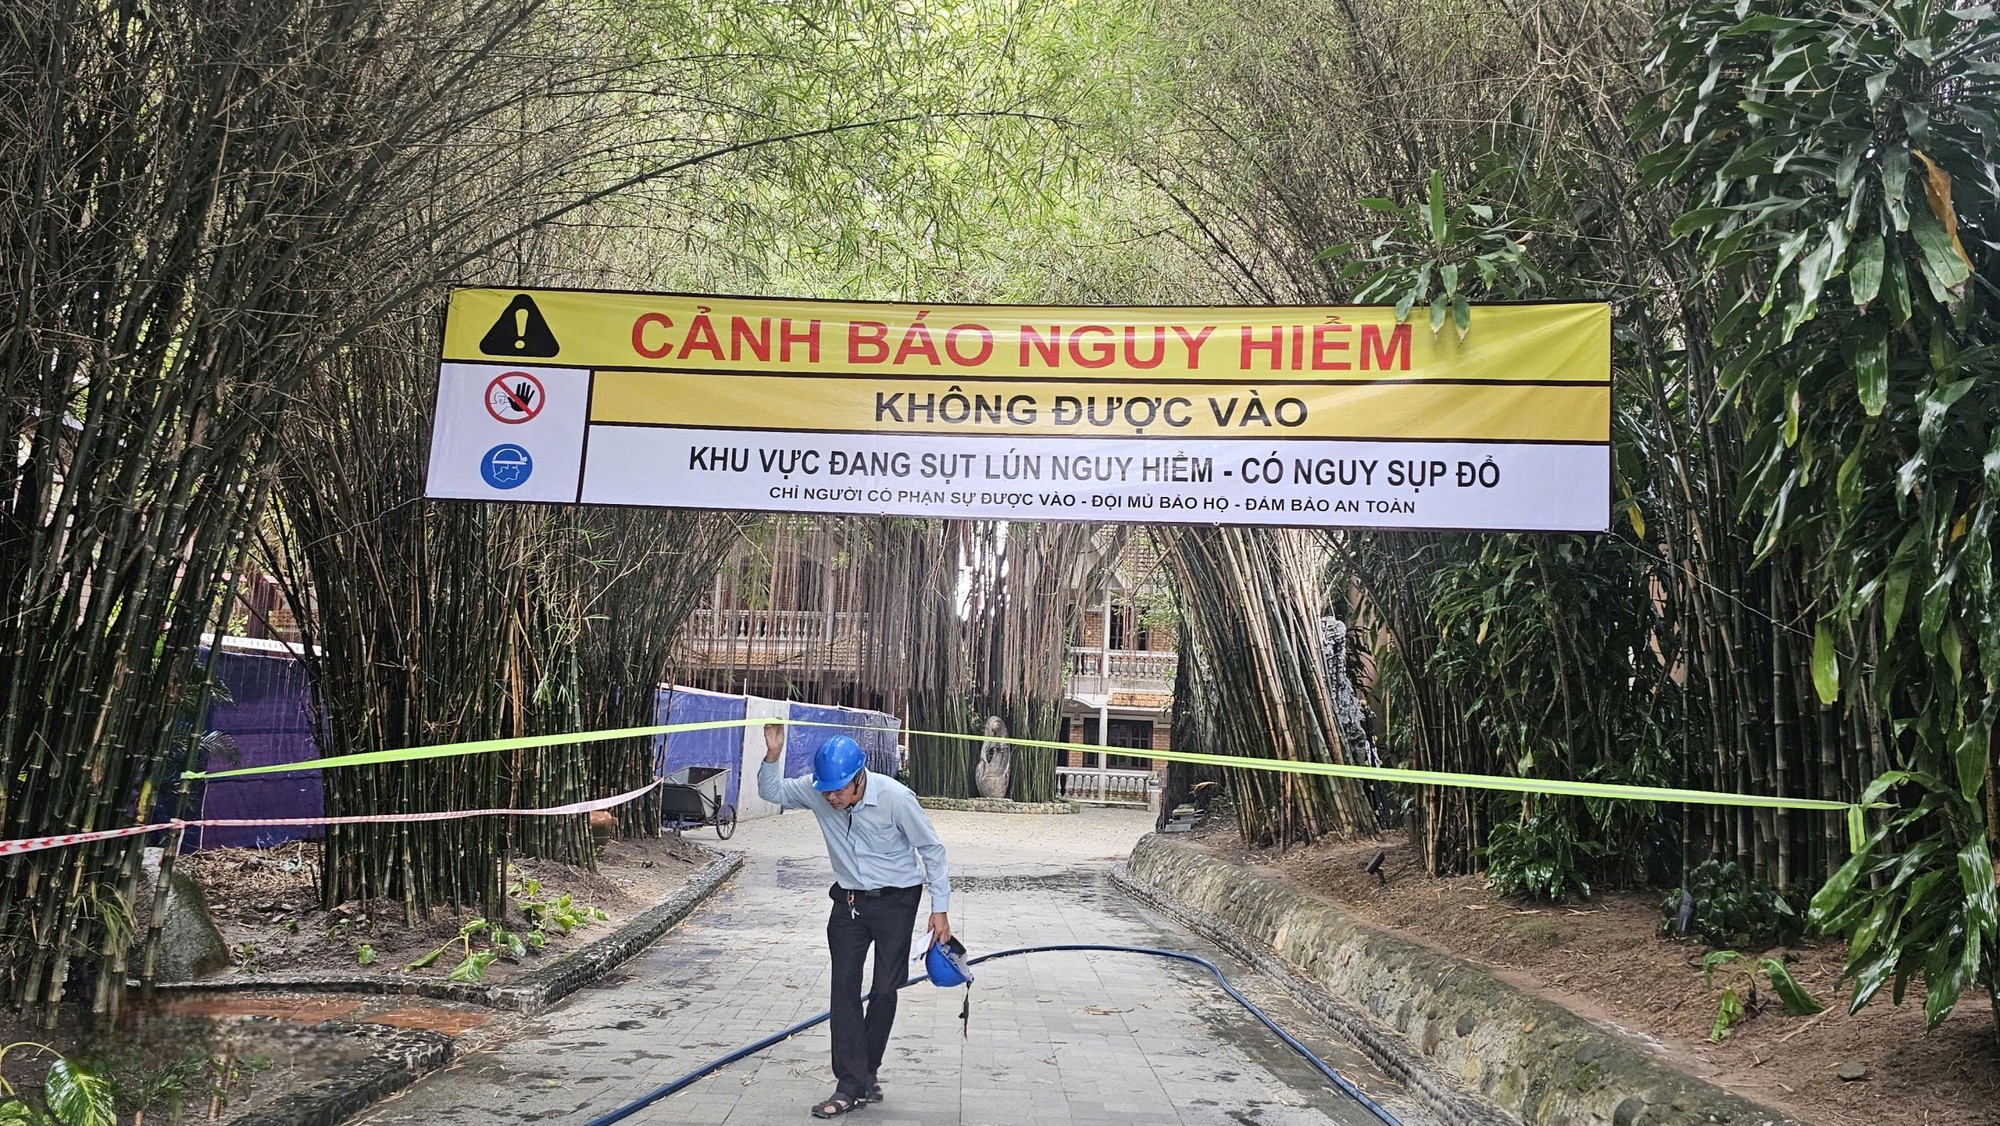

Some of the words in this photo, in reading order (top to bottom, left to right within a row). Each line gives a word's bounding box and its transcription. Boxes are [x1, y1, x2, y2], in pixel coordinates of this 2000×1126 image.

[631, 306, 821, 363] CẢNH
[848, 310, 993, 366] BÁO
[1019, 325, 1215, 369] NGUY
[1240, 315, 1412, 371] HIỂM
[876, 385, 1037, 425] KHÔNG
[1051, 396, 1192, 434] ĐƯỢC
[1208, 390, 1307, 427] VÀO
[690, 446, 749, 472] KHU
[759, 449, 820, 479] VỰC
[829, 451, 910, 477] ĐANG
[921, 453, 976, 484] SỤT
[986, 448, 1040, 479] LÚN
[1052, 456, 1132, 481] NGUY
[1143, 451, 1212, 482] HIỂM
[1242, 451, 1283, 484] CÓ
[1294, 459, 1378, 485] NGUY
[1388, 460, 1446, 493] SỤP
[1456, 455, 1500, 488] ĐỔ
[770, 485, 799, 499] CHỈ
[804, 487, 862, 501] NGƯỜI
[868, 488, 892, 501] CÓ
[951, 493, 976, 506] SỰ
[981, 493, 1033, 508] ĐƯỢC
[1039, 491, 1075, 506] VÀO
[1160, 494, 1197, 509] BẢO
[1245, 496, 1284, 510] ĐẢM
[1292, 497, 1329, 511] BẢO
[1335, 500, 1359, 512] AN
[1366, 498, 1414, 513] TOÀN
